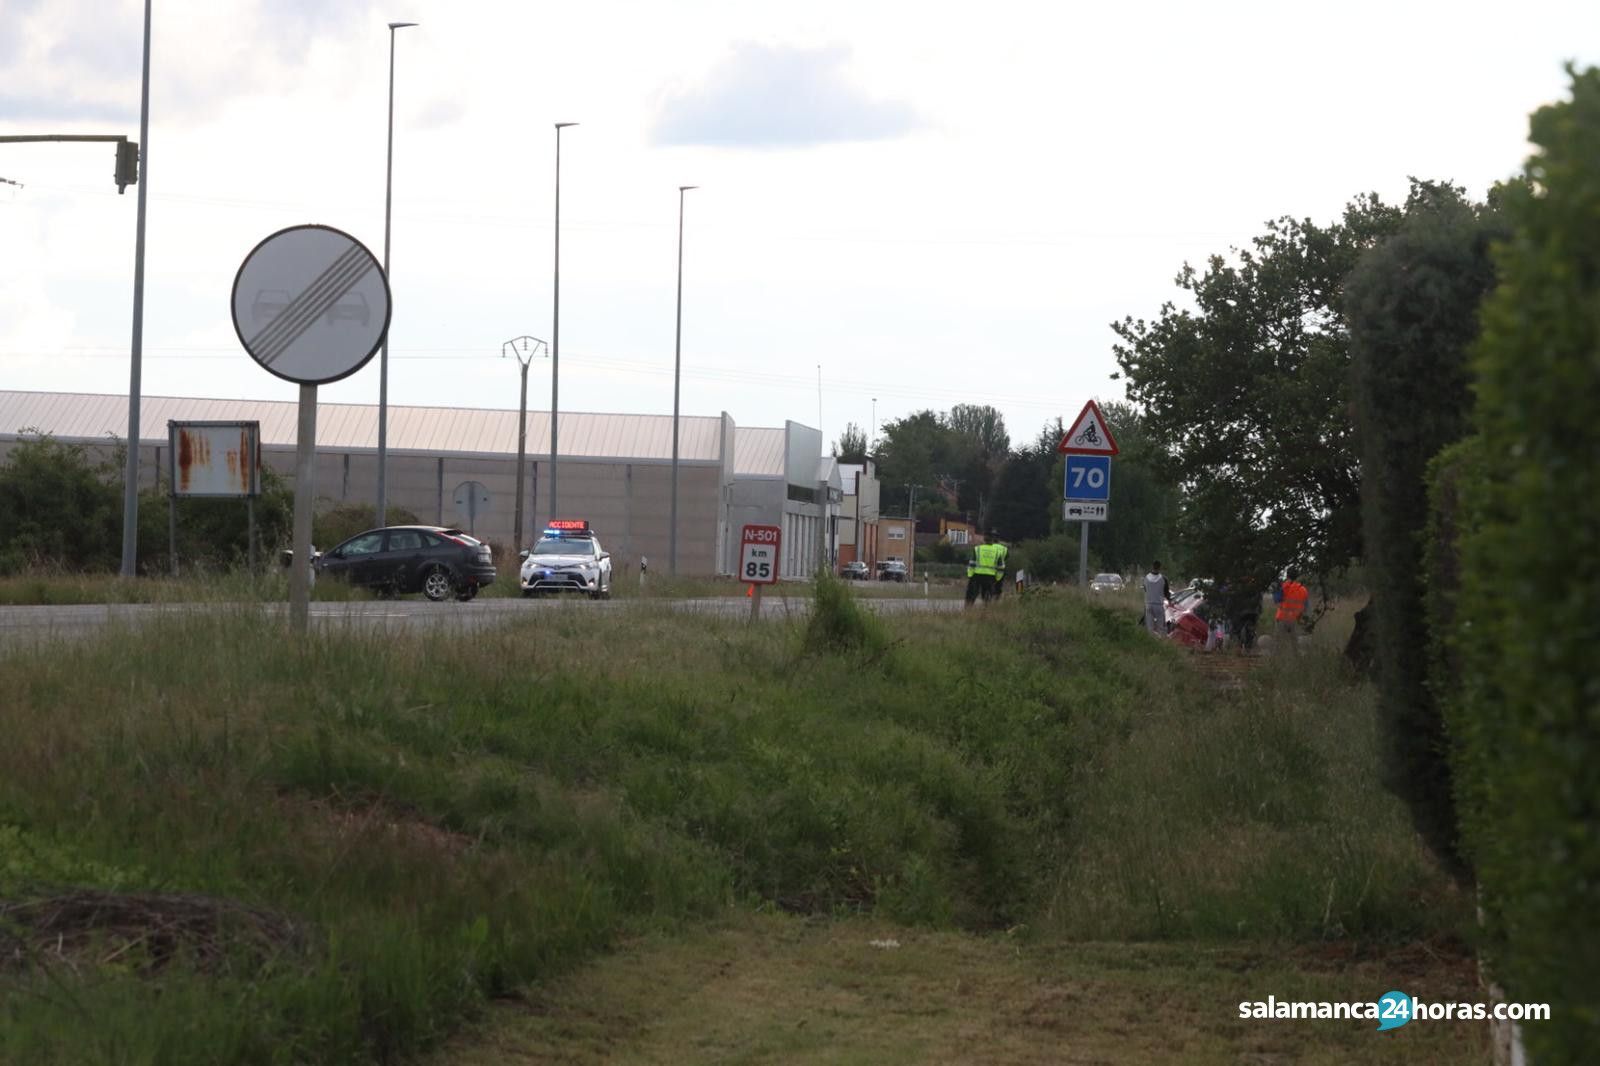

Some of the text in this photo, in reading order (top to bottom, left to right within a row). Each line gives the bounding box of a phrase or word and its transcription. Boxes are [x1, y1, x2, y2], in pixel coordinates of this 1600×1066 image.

[1071, 467, 1105, 489] 70
[744, 529, 777, 542] N-501
[751, 548, 767, 557] km
[746, 562, 770, 578] 85
